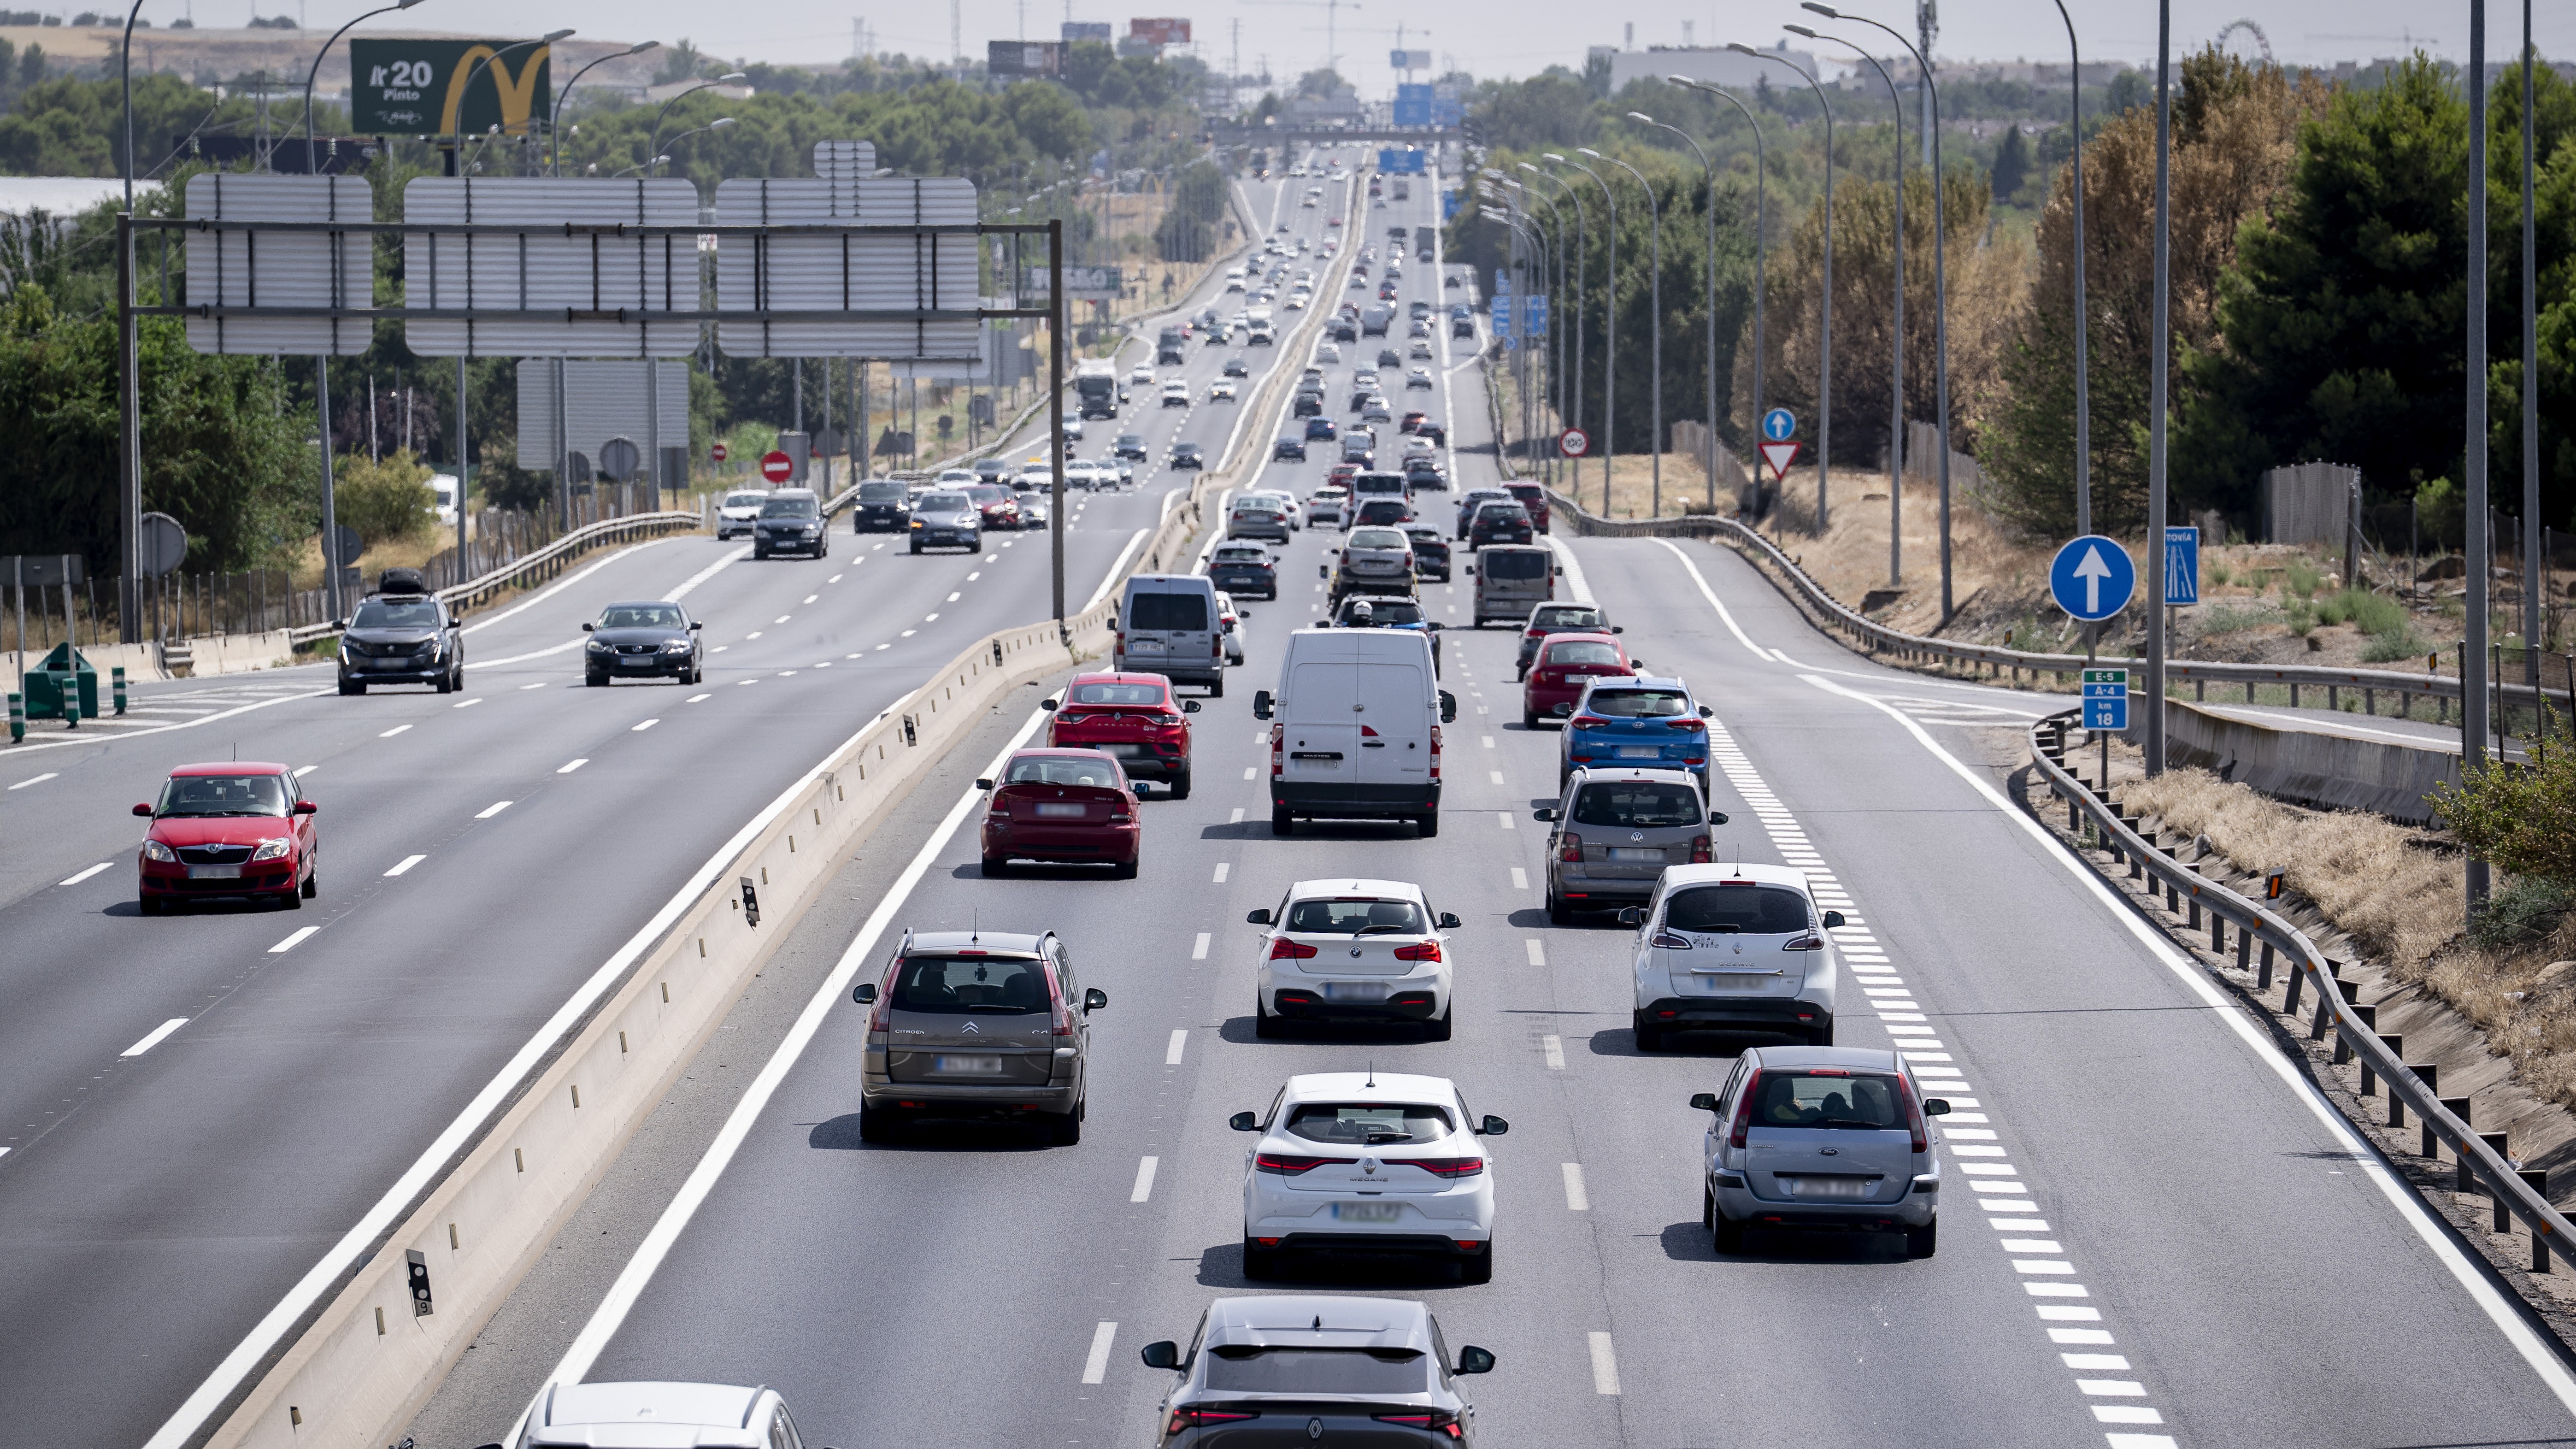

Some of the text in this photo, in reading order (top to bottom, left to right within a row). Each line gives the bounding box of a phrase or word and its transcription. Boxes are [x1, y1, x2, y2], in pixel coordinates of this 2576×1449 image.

[391, 60, 433, 88] 20
[383, 88, 420, 101] Pinto
[1564, 438, 1583, 448] 100
[2165, 531, 2192, 542] TOVÍA
[2095, 672, 2114, 682] E-5
[2094, 686, 2115, 696] A-4
[2098, 701, 2112, 710] km
[2096, 713, 2114, 726] 18
[420, 1302, 428, 1313] 9
